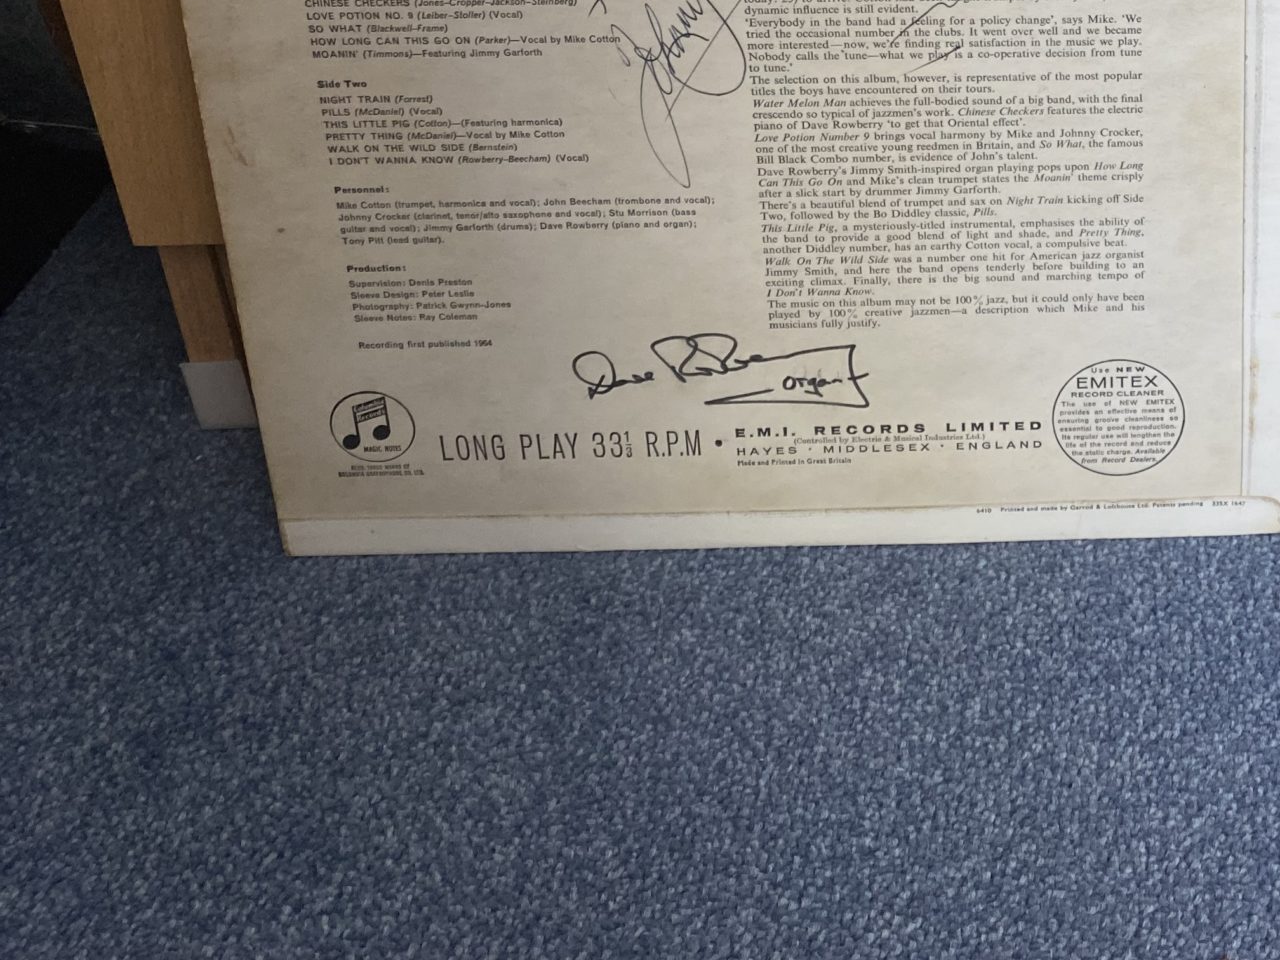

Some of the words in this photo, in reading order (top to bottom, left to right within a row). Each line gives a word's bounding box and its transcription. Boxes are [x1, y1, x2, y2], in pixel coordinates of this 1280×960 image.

[750, 76, 770, 85] The
[774, 75, 818, 85] selection
[841, 75, 859, 84] this
[864, 74, 899, 85] album,
[904, 74, 950, 84] however,
[954, 73, 962, 83] is
[966, 73, 1036, 85] representative
[1040, 72, 1052, 82] of
[1055, 72, 1070, 82] the
[1075, 72, 1099, 81] most
[1104, 71, 1143, 84] popular
[769, 319, 817, 329] musicians
[821, 319, 843, 329] fully
[846, 319, 880, 329] justify.
[1090, 366, 1109, 374] Use
[1116, 365, 1145, 373] NEW
[1077, 375, 1158, 391] EMITEX
[735, 427, 796, 438] E.M.I.
[814, 423, 926, 435] RECORDS
[946, 421, 1042, 432] LIMITED
[439, 434, 505, 461] LONG
[519, 432, 577, 460] PLAY
[645, 429, 701, 457] R.P.M
[736, 446, 798, 456] HAYES
[823, 443, 930, 453] MIDDLESEX
[956, 440, 1043, 450] ENGLAND
